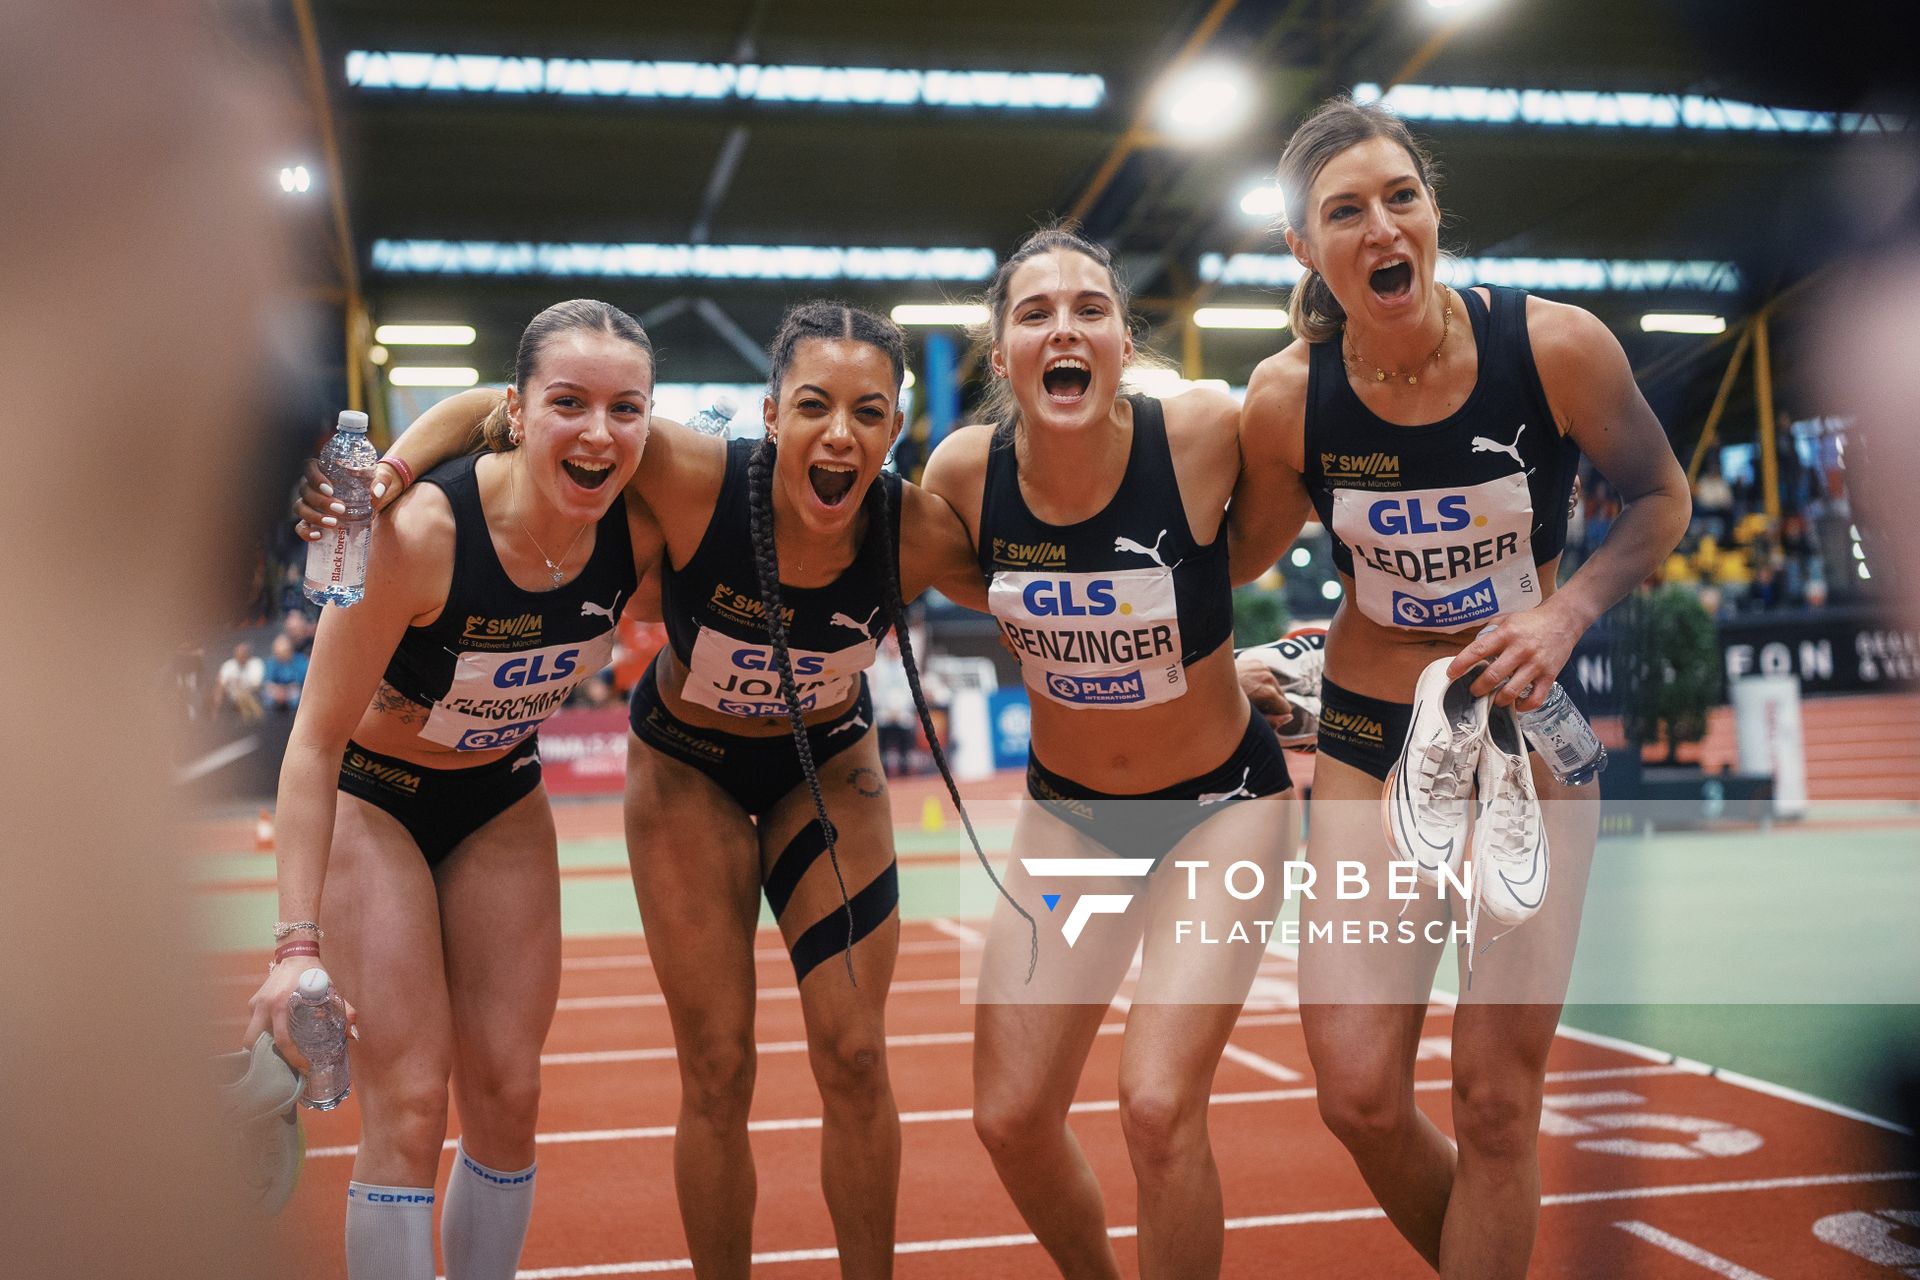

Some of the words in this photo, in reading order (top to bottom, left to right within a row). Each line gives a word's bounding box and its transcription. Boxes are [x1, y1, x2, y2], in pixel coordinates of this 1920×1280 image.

[1367, 478, 1402, 487] München
[332, 557, 342, 582] Black
[337, 526, 346, 552] Forest
[1355, 531, 1518, 584] LEDERER
[1519, 573, 1533, 594] 107
[1433, 588, 1492, 617] PLAN
[1436, 606, 1494, 624] INTERNATIONAL
[471, 640, 511, 649] Stadtwerke
[512, 638, 542, 648] München
[1004, 621, 1174, 664] BENZINGER
[1165, 663, 1179, 685] 100
[1083, 678, 1139, 695] PLAN
[1085, 693, 1140, 701] INTERNATIONAL
